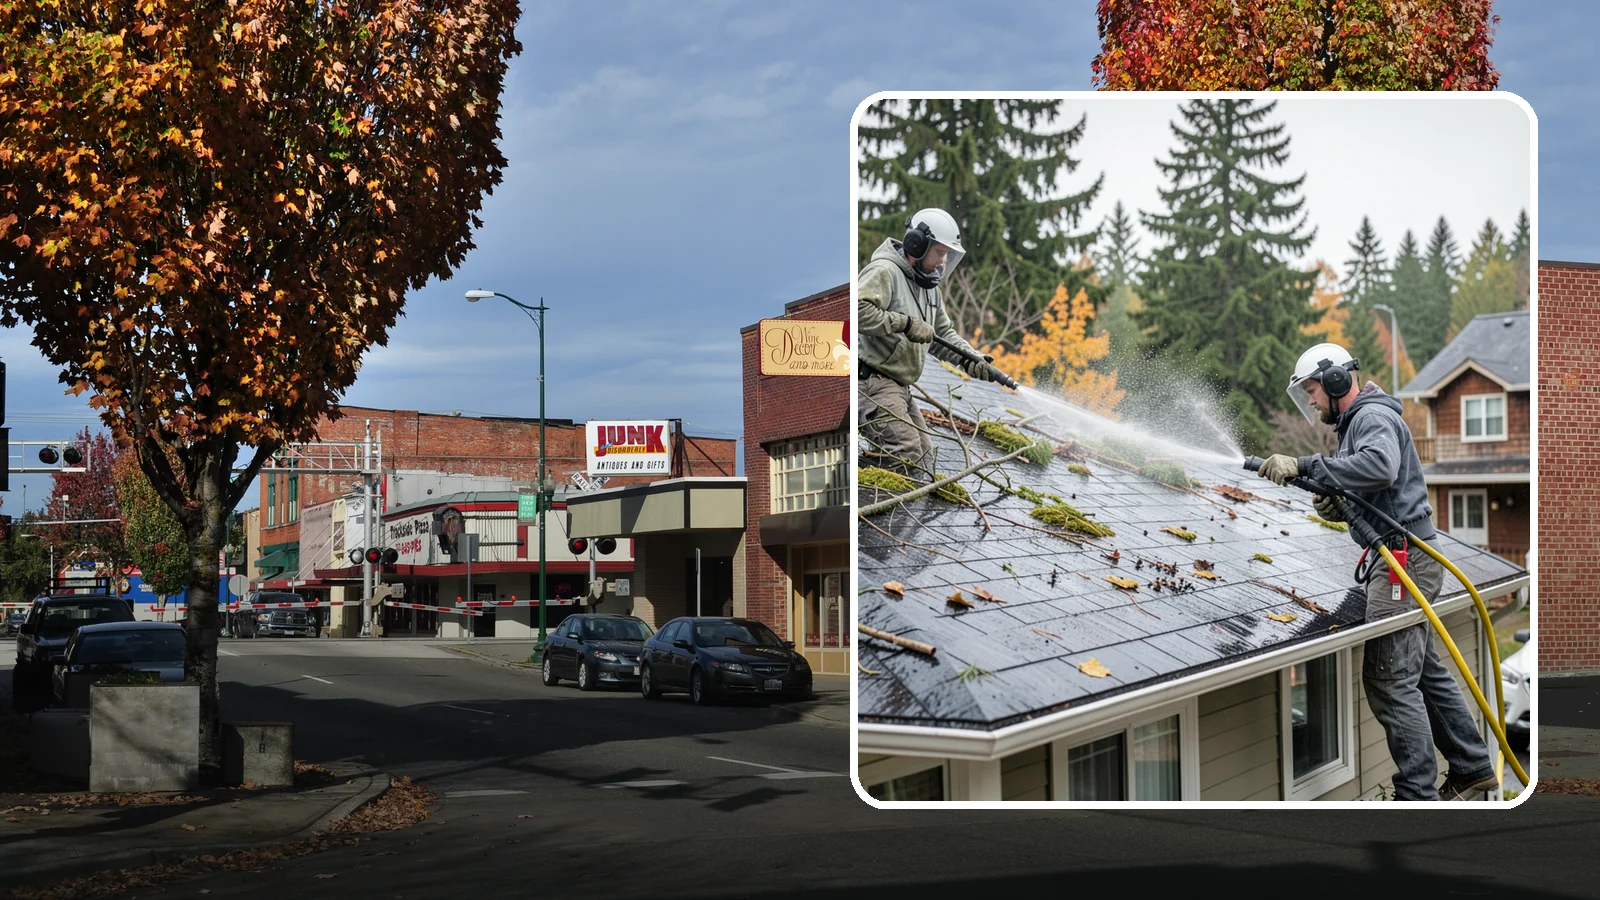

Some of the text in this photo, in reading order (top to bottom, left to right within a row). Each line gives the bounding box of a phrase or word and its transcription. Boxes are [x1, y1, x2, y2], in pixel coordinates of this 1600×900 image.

[595, 425, 665, 457] JUNK
[607, 446, 646, 454] DISORDERLY
[597, 460, 665, 470] ANTIQUES AND GIFTS
